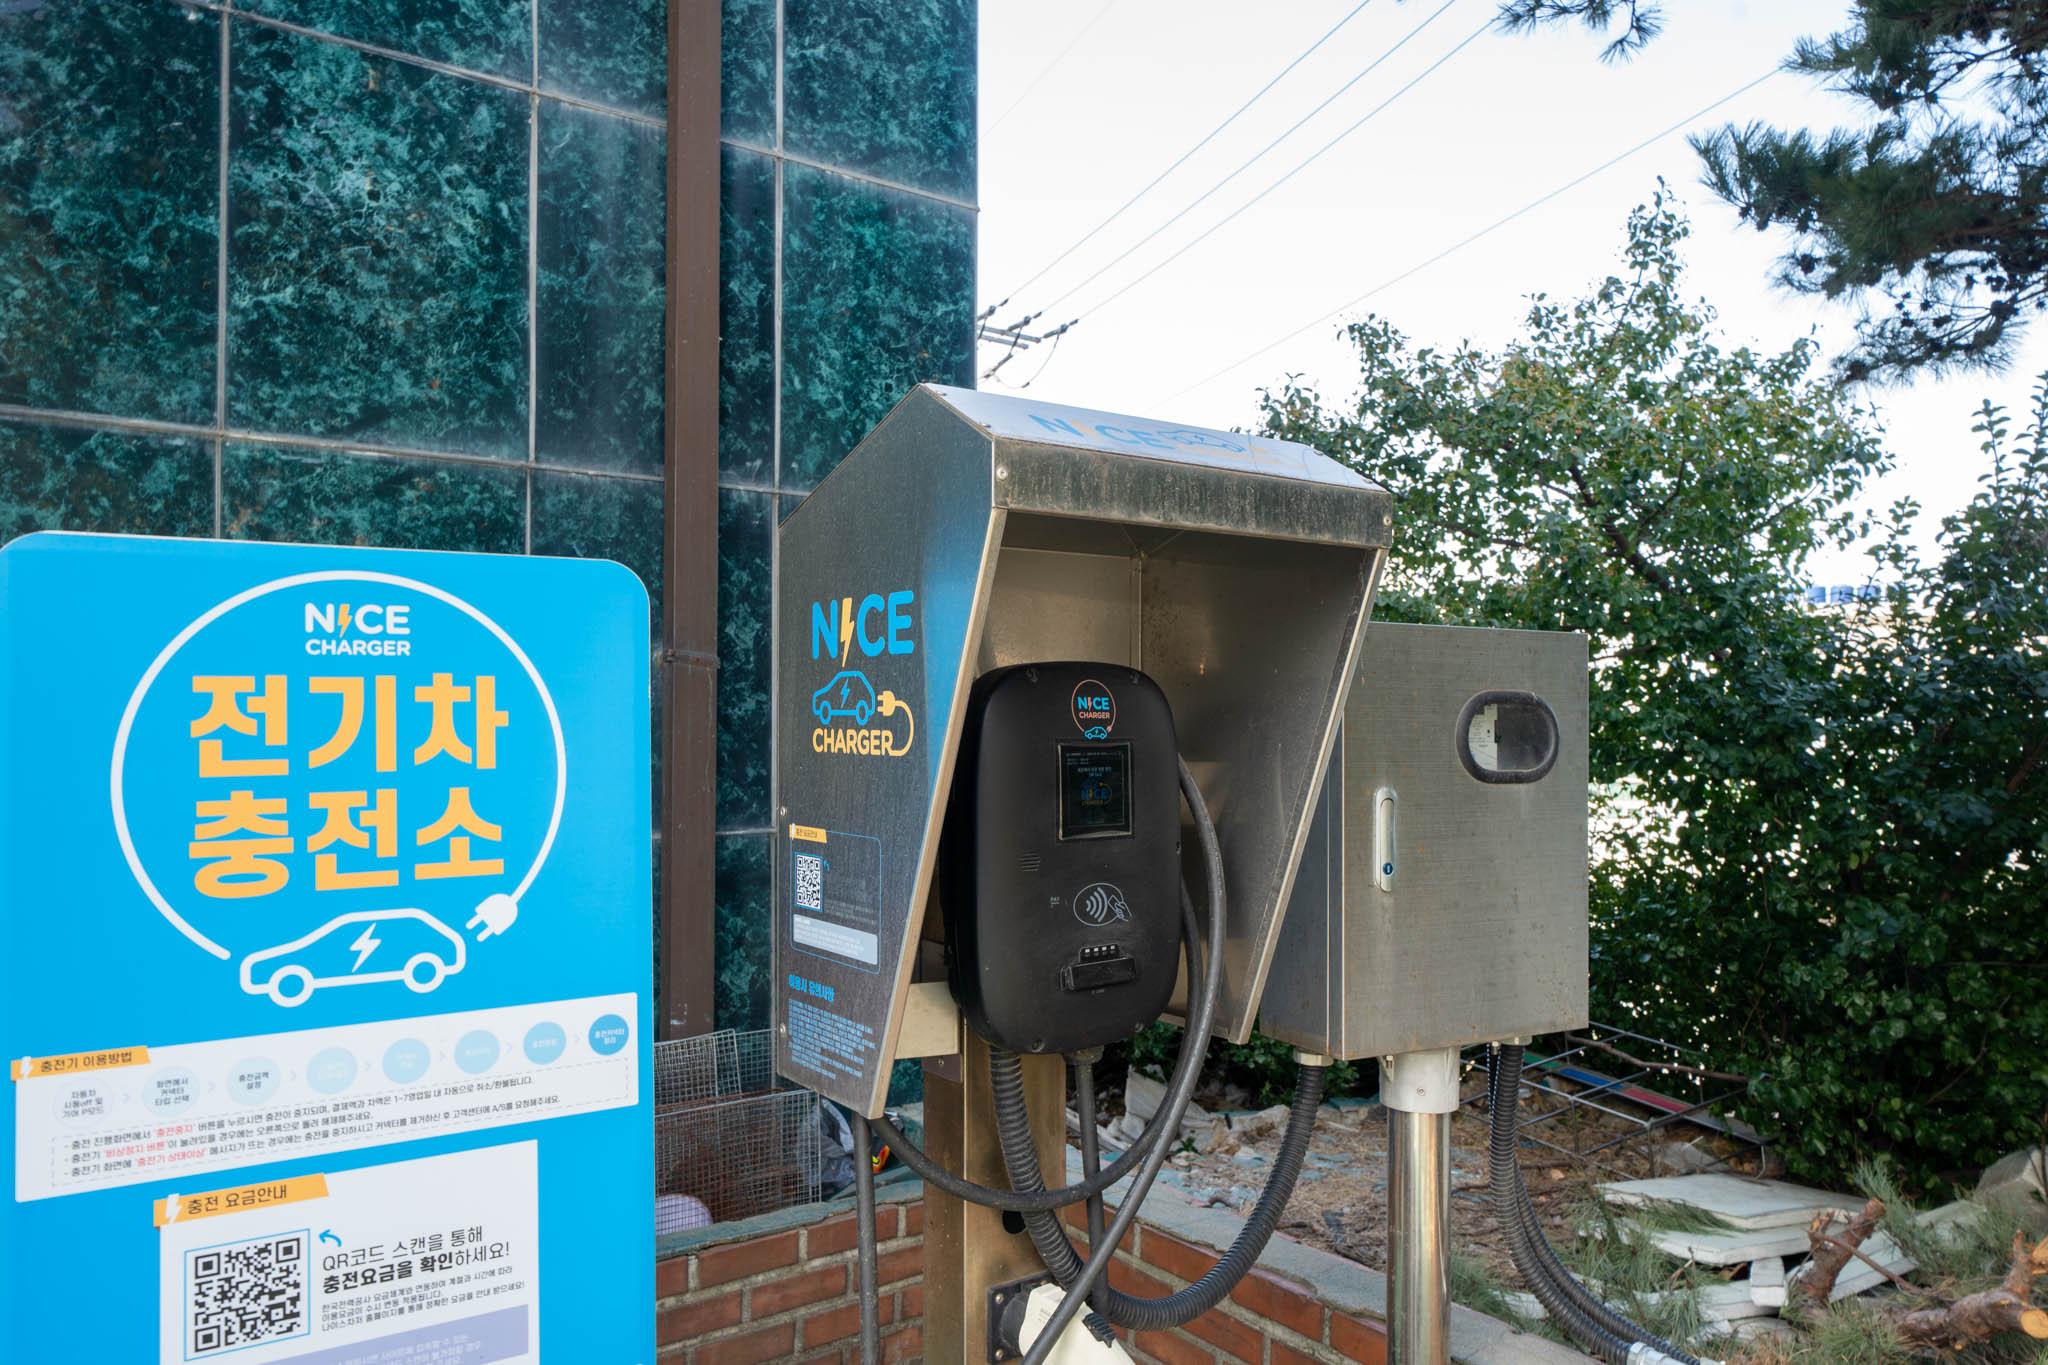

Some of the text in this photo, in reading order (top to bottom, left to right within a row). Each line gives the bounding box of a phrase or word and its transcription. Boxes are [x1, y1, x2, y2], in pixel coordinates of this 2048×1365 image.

[1027, 413, 1176, 450] NICE
[305, 602, 410, 636] NICE
[812, 590, 914, 666] NICE
[305, 638, 411, 658] CHARGER
[1077, 695, 1110, 710] NICE
[1078, 711, 1110, 719] CHARGER
[190, 673, 508, 779] 전기차
[812, 727, 895, 757] CHARGER
[188, 786, 504, 900] 충전소
[40, 1050, 132, 1072] 충전기 이용방법
[188, 1183, 287, 1215] 충전 요금안내
[322, 1224, 482, 1273] QR코드 스캔을 통해
[322, 1240, 509, 1295] 충전요금을 확인하세요!
